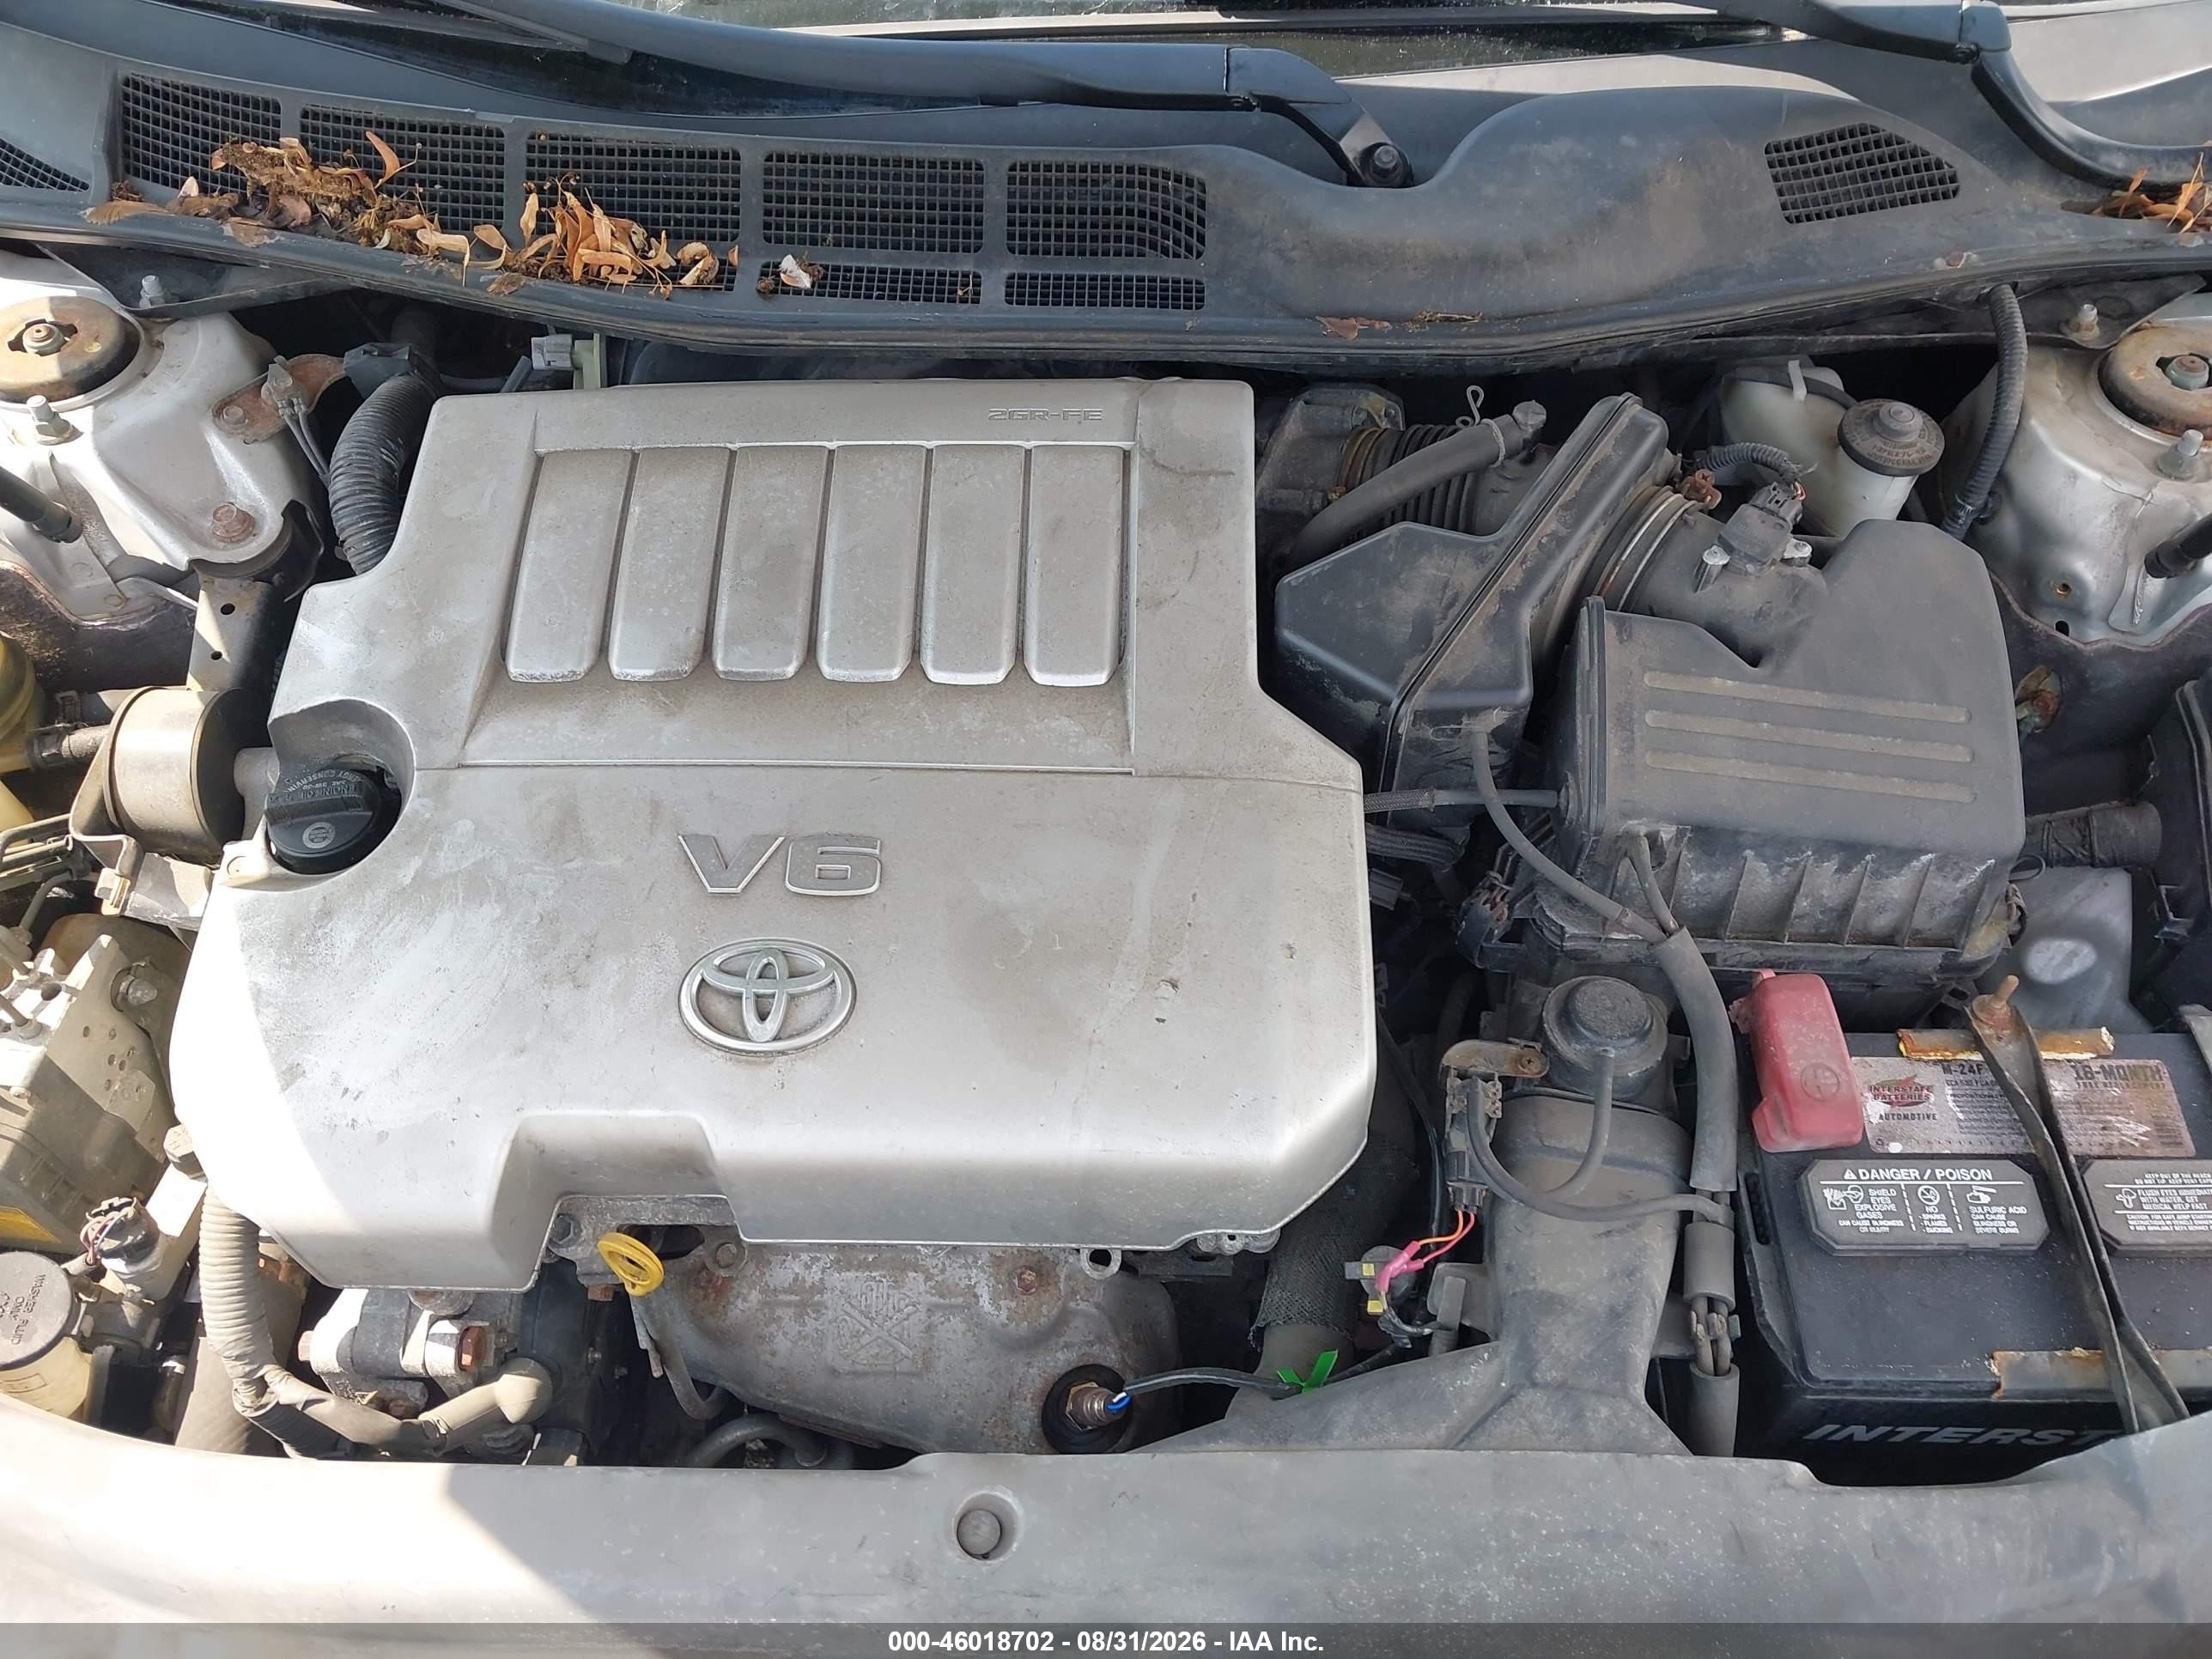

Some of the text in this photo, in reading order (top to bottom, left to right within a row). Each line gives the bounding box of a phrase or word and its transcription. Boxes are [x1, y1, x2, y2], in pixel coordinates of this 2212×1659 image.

[988, 408, 1103, 421] 2GR-FE
[678, 832, 882, 897] V6
[1869, 1085, 1932, 1093] INTERSTATE
[1858, 1169, 1992, 1180] DANGER / POISON
[1969, 1206, 2027, 1214] SULFURIC ACID
[11, 1274, 46, 1345] WASHER FLUID
